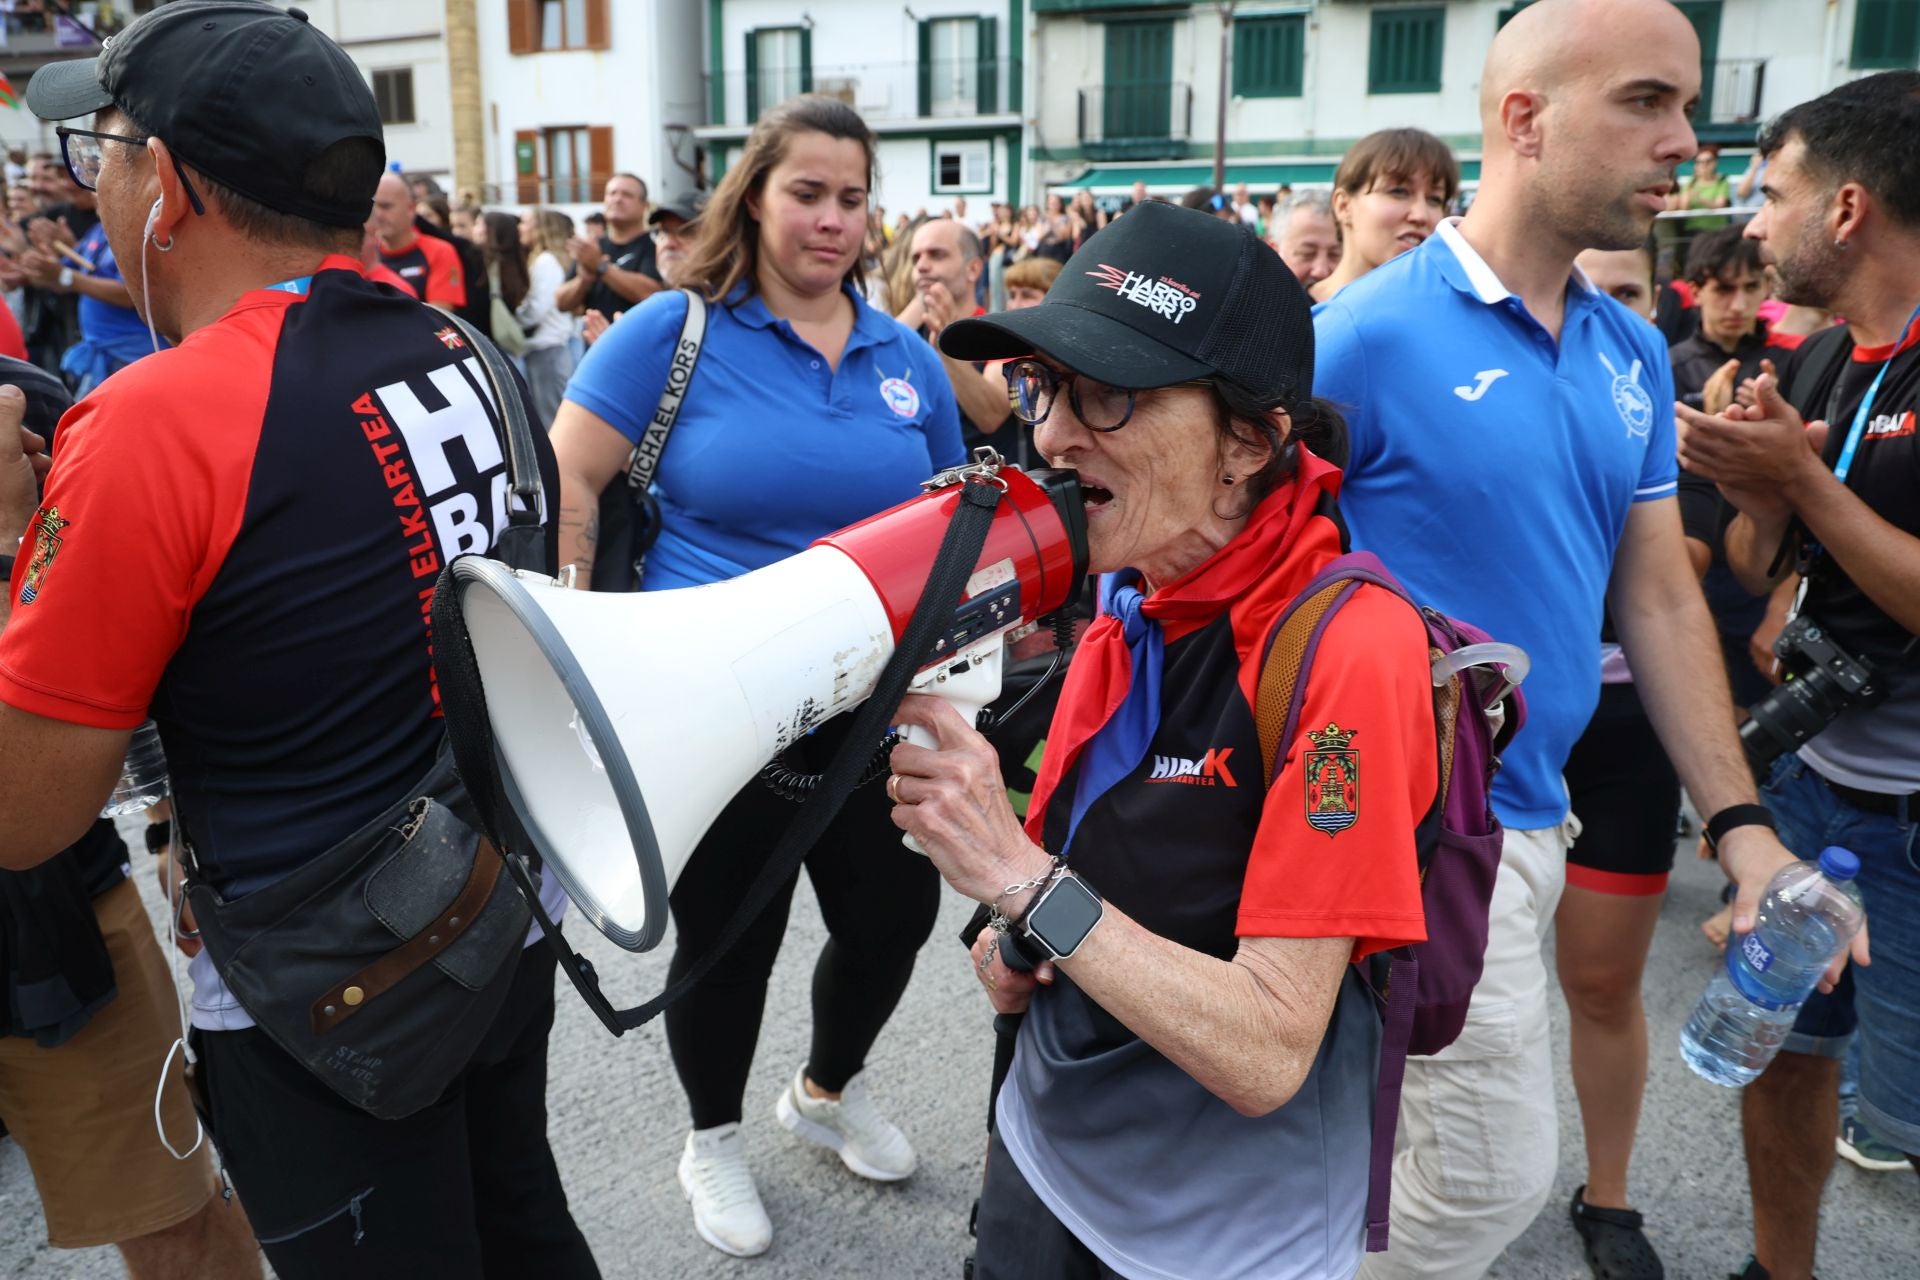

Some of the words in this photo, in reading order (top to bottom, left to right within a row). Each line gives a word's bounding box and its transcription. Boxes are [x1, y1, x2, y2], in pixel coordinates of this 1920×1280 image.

[1117, 271, 1197, 313] HARRO
[664, 338, 698, 399] KORS
[350, 391, 440, 579] ELKARTEA
